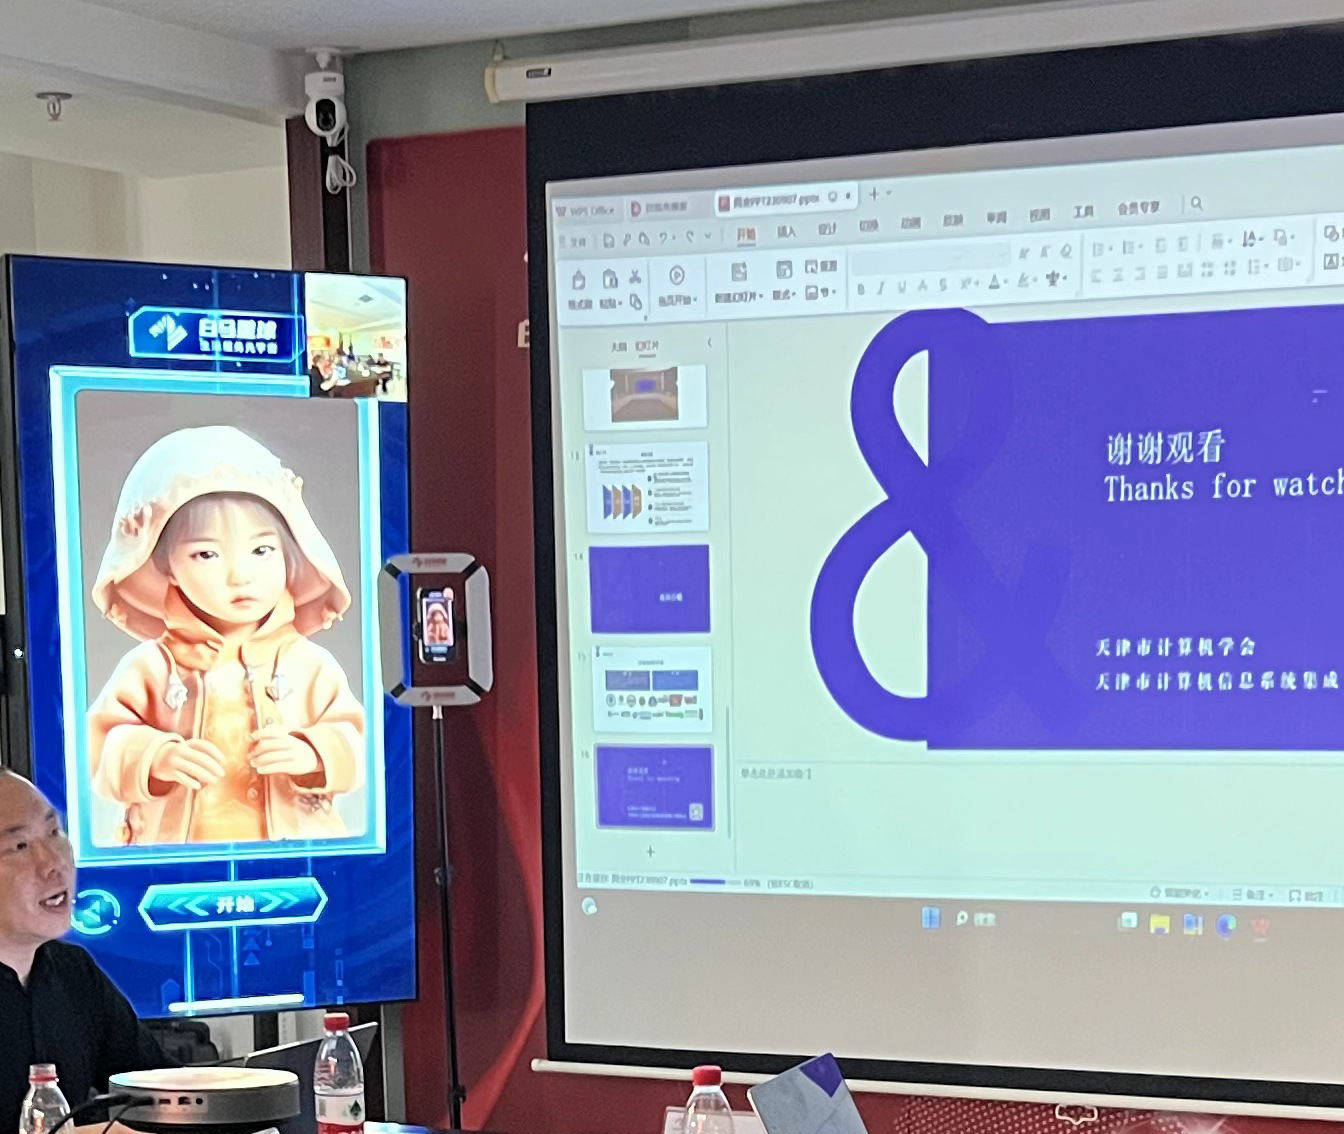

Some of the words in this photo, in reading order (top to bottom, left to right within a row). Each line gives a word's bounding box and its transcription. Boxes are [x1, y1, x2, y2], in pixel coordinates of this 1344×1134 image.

[1107, 428, 1226, 466] 谢谢观看
[1104, 473, 1194, 502] Thanks
[1212, 471, 1257, 499] for
[1095, 636, 1257, 657] 天津市计算机学会
[216, 895, 255, 914] 开始
